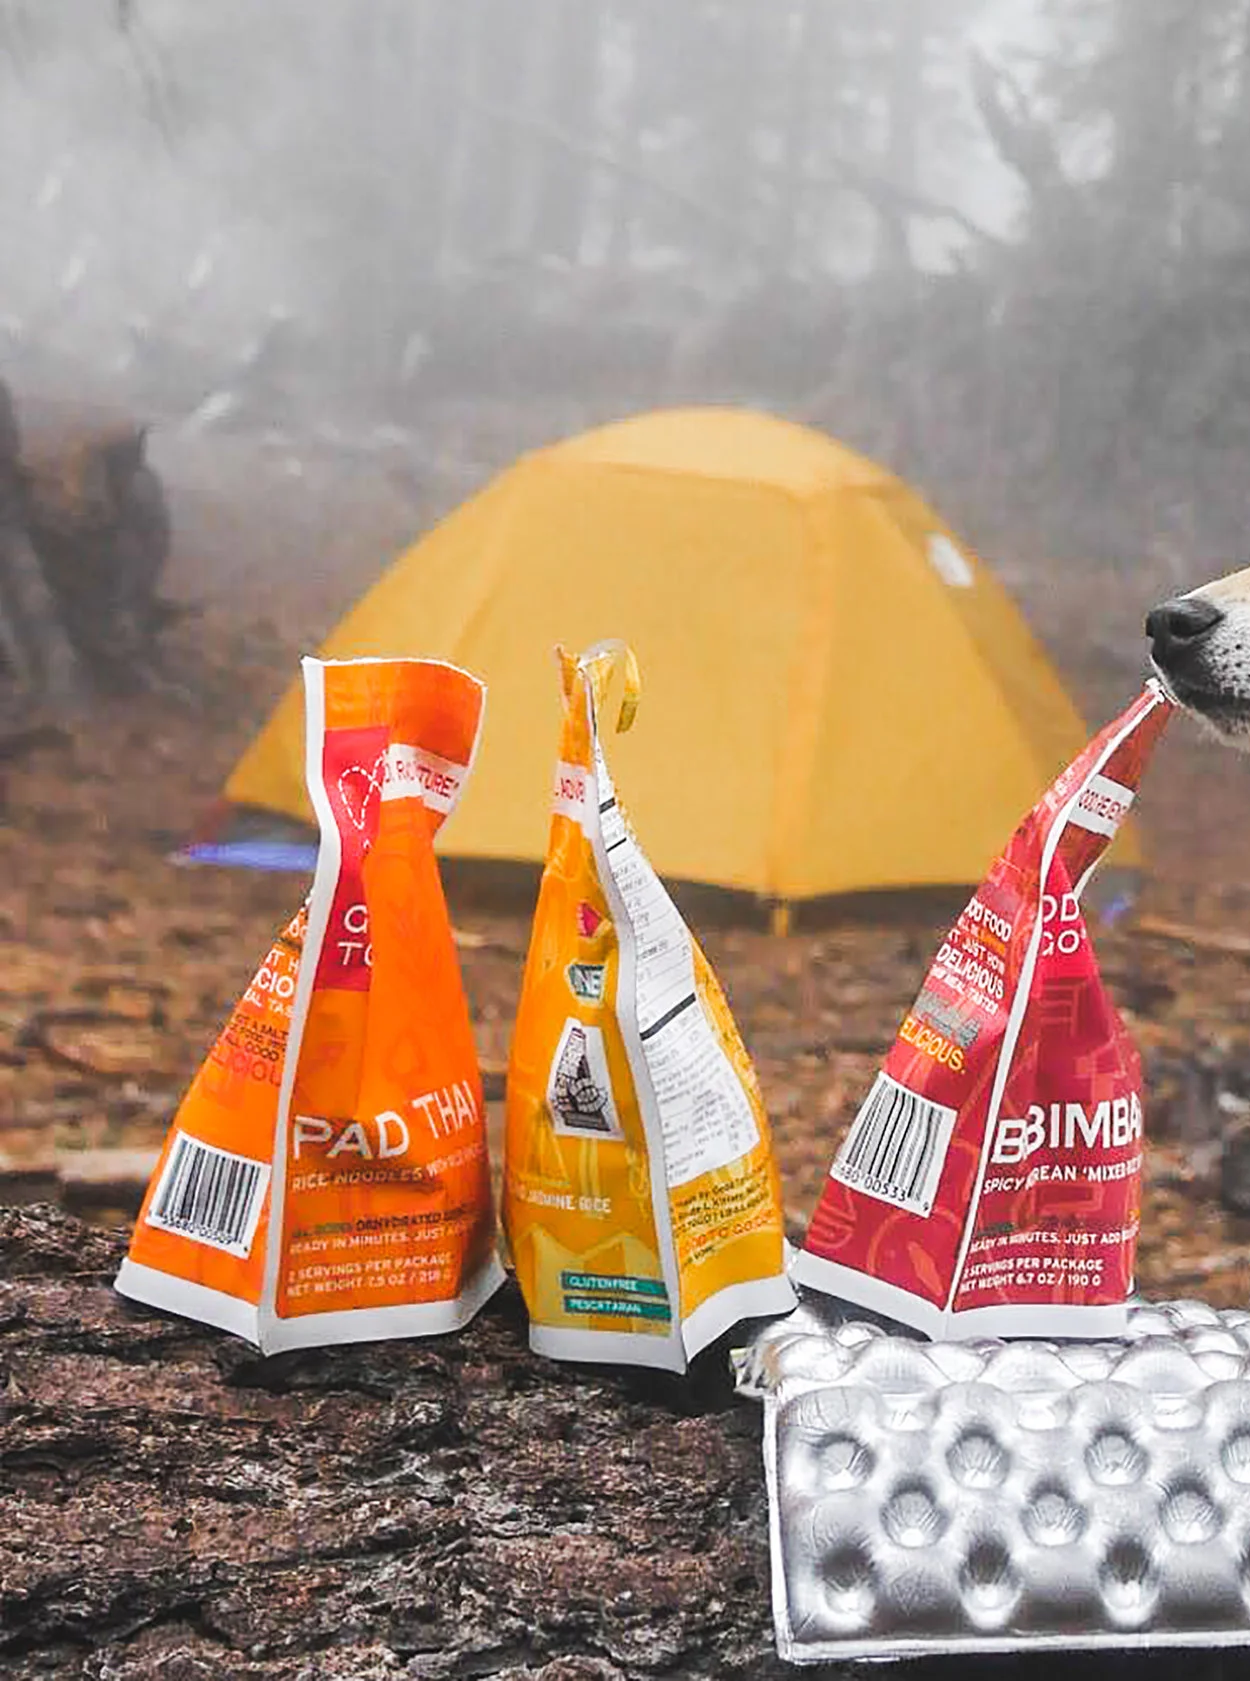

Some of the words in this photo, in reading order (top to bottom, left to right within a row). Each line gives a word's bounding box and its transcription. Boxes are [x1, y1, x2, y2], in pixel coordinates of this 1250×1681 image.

[983, 912, 1012, 942] FOOD
[962, 937, 986, 961] JUST
[936, 942, 1004, 999] DELICIOUS
[293, 1110, 410, 1160] PAD
[412, 1080, 479, 1139] THAI
[292, 1174, 329, 1191] RICE
[334, 1167, 423, 1184] NOODLES
[983, 1177, 1025, 1195] SPICY
[1065, 1233, 1096, 1245] JUST
[299, 1263, 361, 1280] SERVINGS
[366, 1260, 390, 1272] PER
[970, 1258, 1014, 1277] SERVINGS
[1016, 1258, 1041, 1269] PER
[1043, 1258, 1103, 1271] PACKAGE
[1037, 1273, 1055, 1284] OZ
[1067, 1273, 1089, 1286] 190
